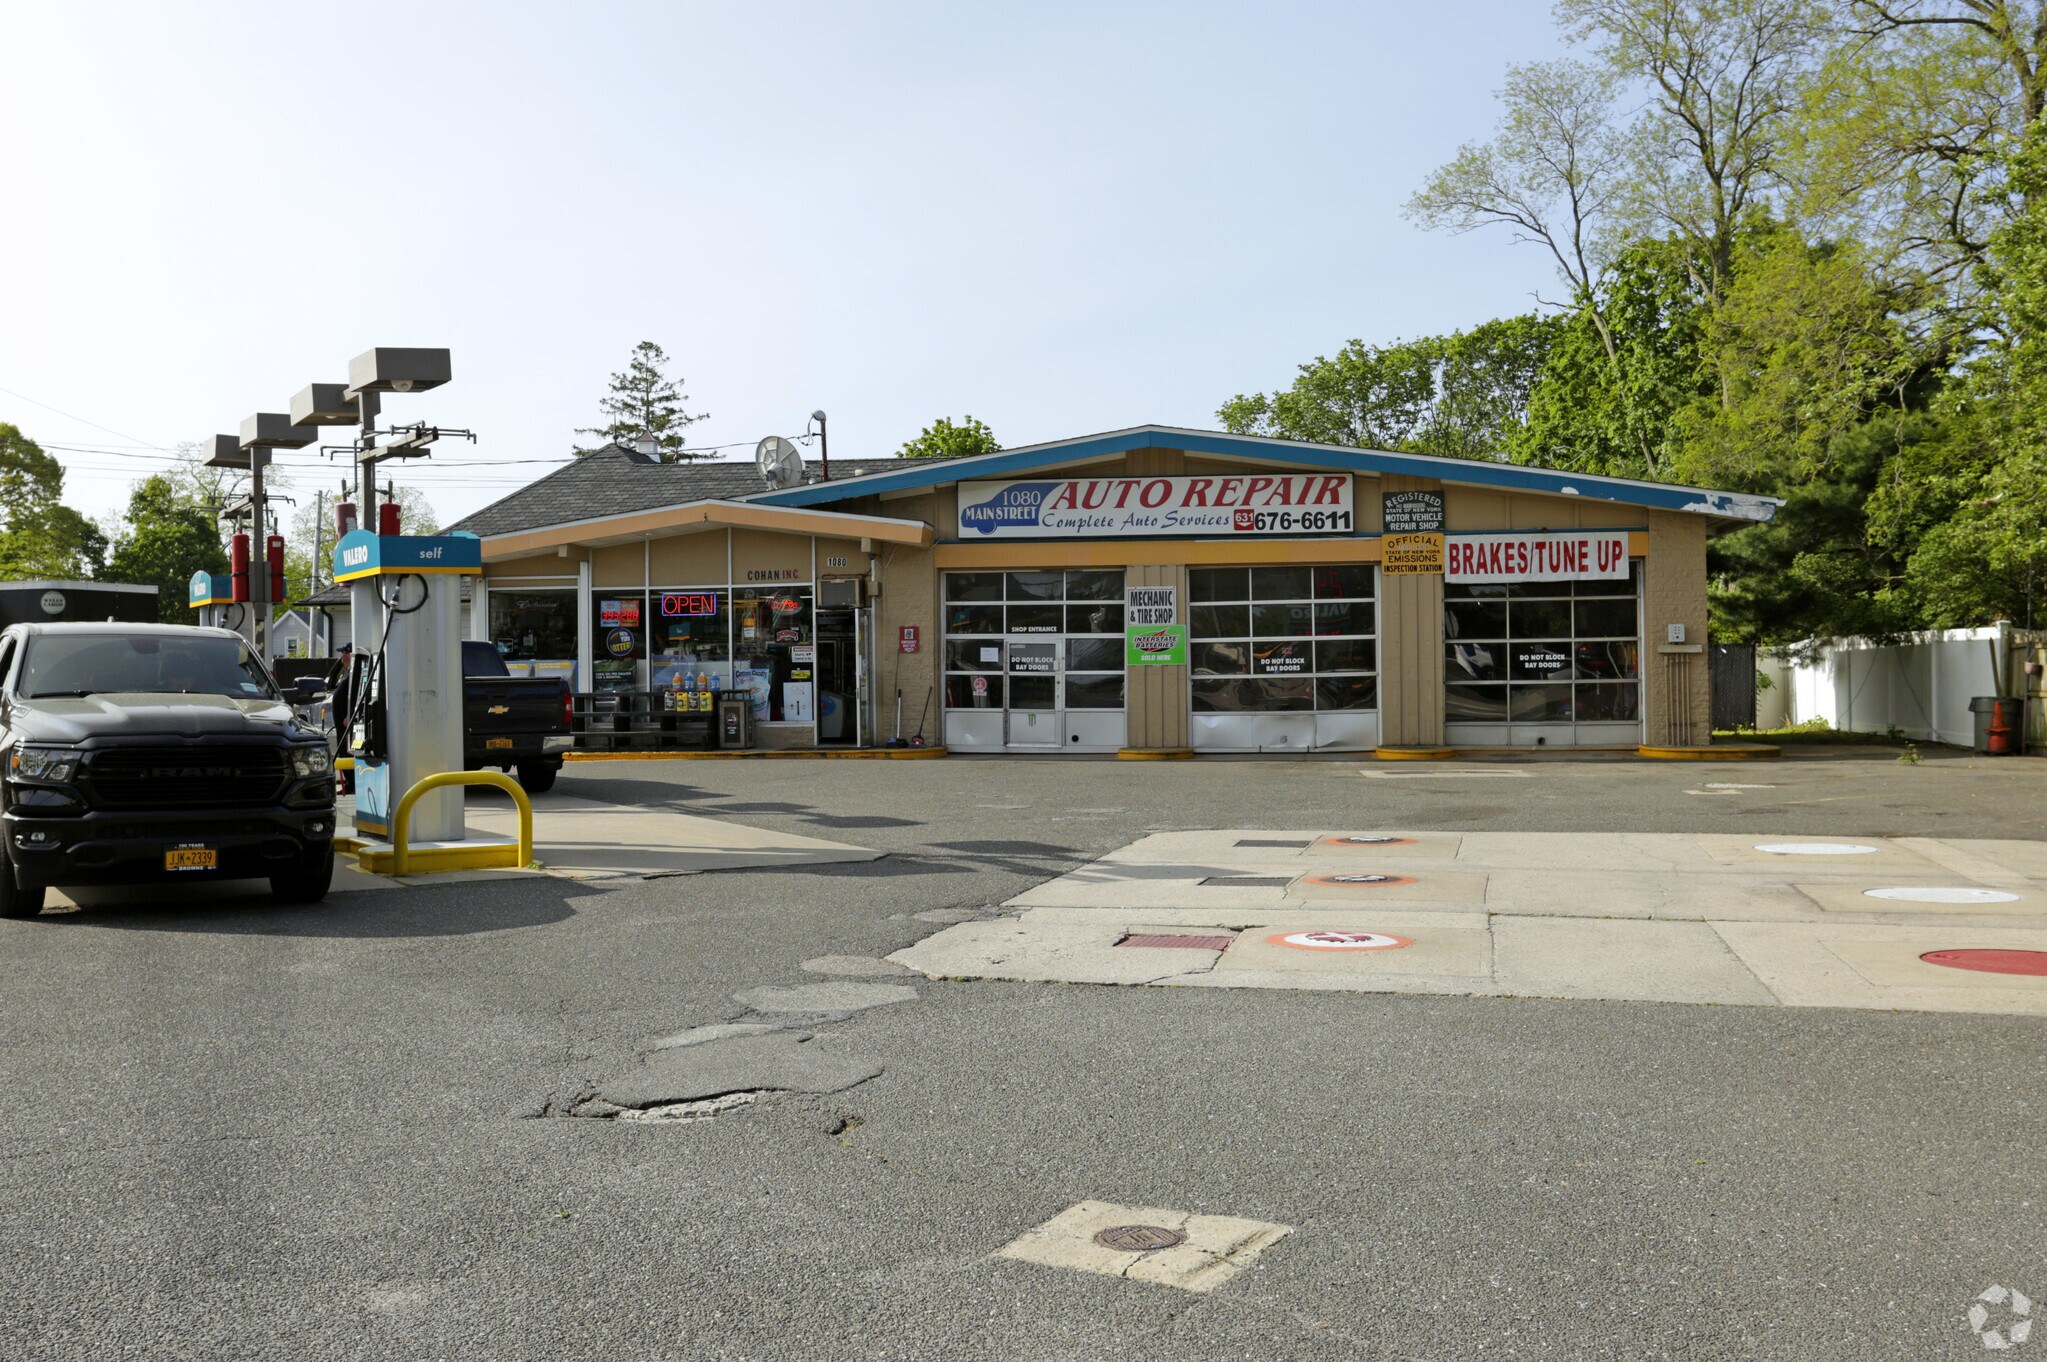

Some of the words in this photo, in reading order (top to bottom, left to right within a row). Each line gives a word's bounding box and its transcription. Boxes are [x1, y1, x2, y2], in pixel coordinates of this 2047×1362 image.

[1002, 491, 1040, 506] 1080
[1049, 480, 1172, 511] AUTO
[1179, 477, 1346, 508] REPAIR
[1386, 492, 1441, 508] REGISTERED
[966, 507, 996, 520] MAIN
[996, 505, 1037, 520] STREET
[1385, 514, 1410, 522] MOTOR
[1412, 513, 1443, 521] VEHICLE
[1042, 512, 1113, 533] Complete
[1120, 511, 1157, 531] Auto
[1160, 510, 1229, 529] Services
[1235, 514, 1254, 522] 631
[1254, 511, 1350, 531] 676-6611
[1390, 522, 1417, 531] REPAIR
[1418, 521, 1439, 530] SHOP
[1388, 536, 1439, 548] OFFICIAL
[343, 544, 368, 567] VALERO
[419, 548, 443, 560] self
[1388, 555, 1438, 563] EMISSIONS
[1449, 540, 1589, 574] BRAKES/TUNE
[1598, 540, 1623, 571] UP
[828, 558, 847, 567] 1080
[1418, 564, 1442, 572] STATION
[747, 570, 779, 581] COHAN
[782, 569, 800, 579] INC.
[664, 596, 714, 614] OPEN
[1130, 591, 1172, 607] MECHANIC
[1130, 610, 1136, 622] &
[1137, 609, 1153, 624] TIRE
[1154, 608, 1173, 624] SHOP
[152, 768, 230, 778] RAM
